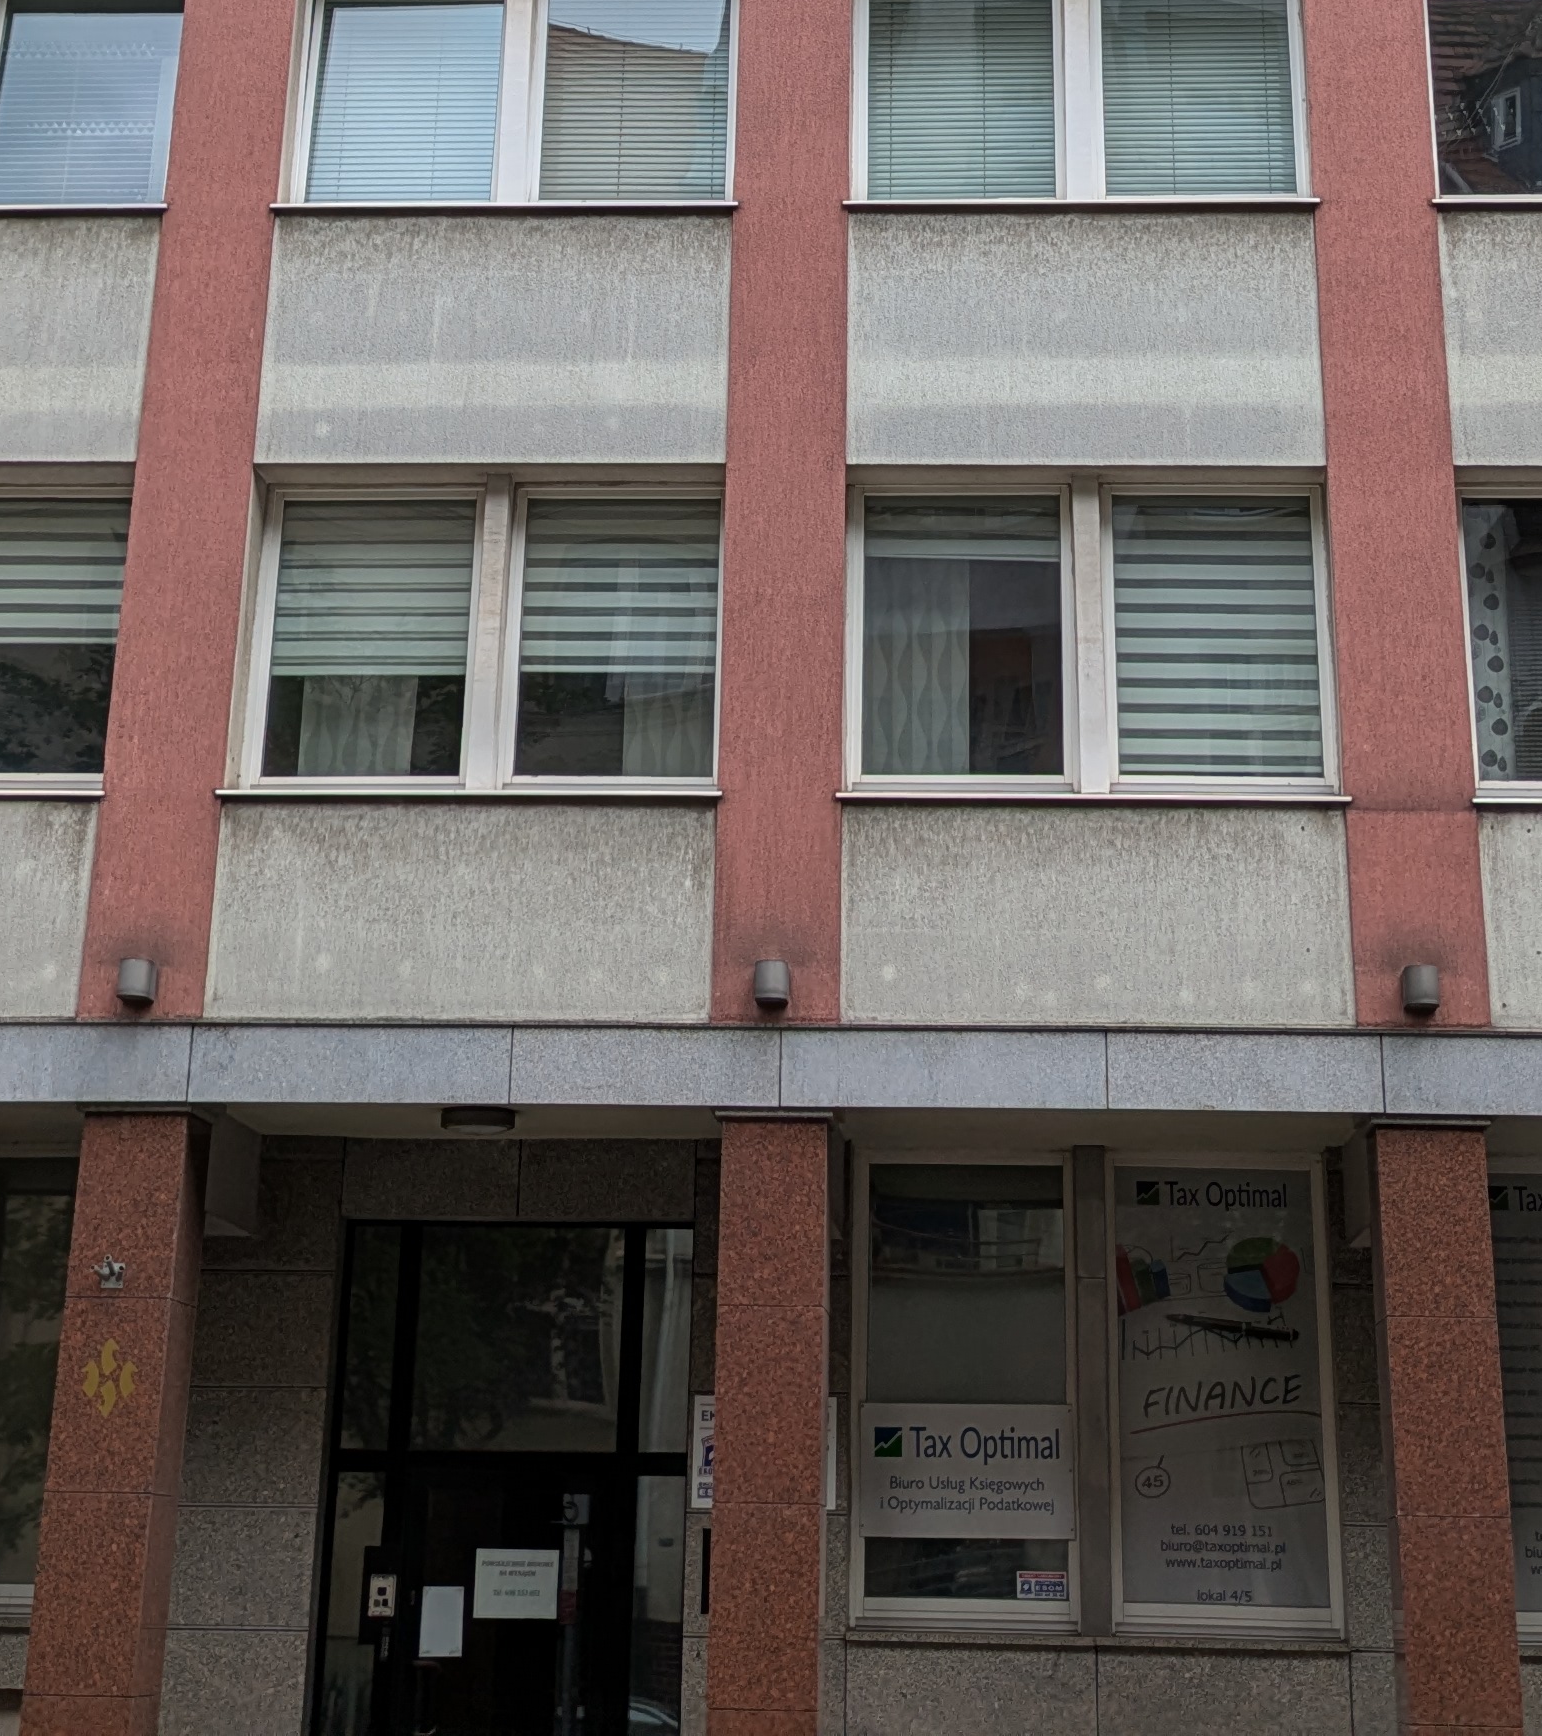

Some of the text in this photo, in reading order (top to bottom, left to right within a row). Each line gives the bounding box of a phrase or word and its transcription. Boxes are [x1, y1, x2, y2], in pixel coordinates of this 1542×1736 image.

[1164, 1181, 1288, 1212] Tax Optimal
[1143, 1374, 1302, 1418] FINANCE
[909, 1426, 1060, 1466] Tax Optimal
[889, 1476, 1045, 1495] Biuro Usług Księgowych
[1141, 1474, 1164, 1489] 45
[880, 1496, 1055, 1515] i Optymalizacji Podatkowej
[1171, 1523, 1273, 1538] tel. 604 919 151
[1160, 1539, 1287, 1555] biuro@taxoptimal.pl
[1165, 1557, 1282, 1572] www.taxoptimal.pl
[1197, 1589, 1253, 1604] lokal 4/5
